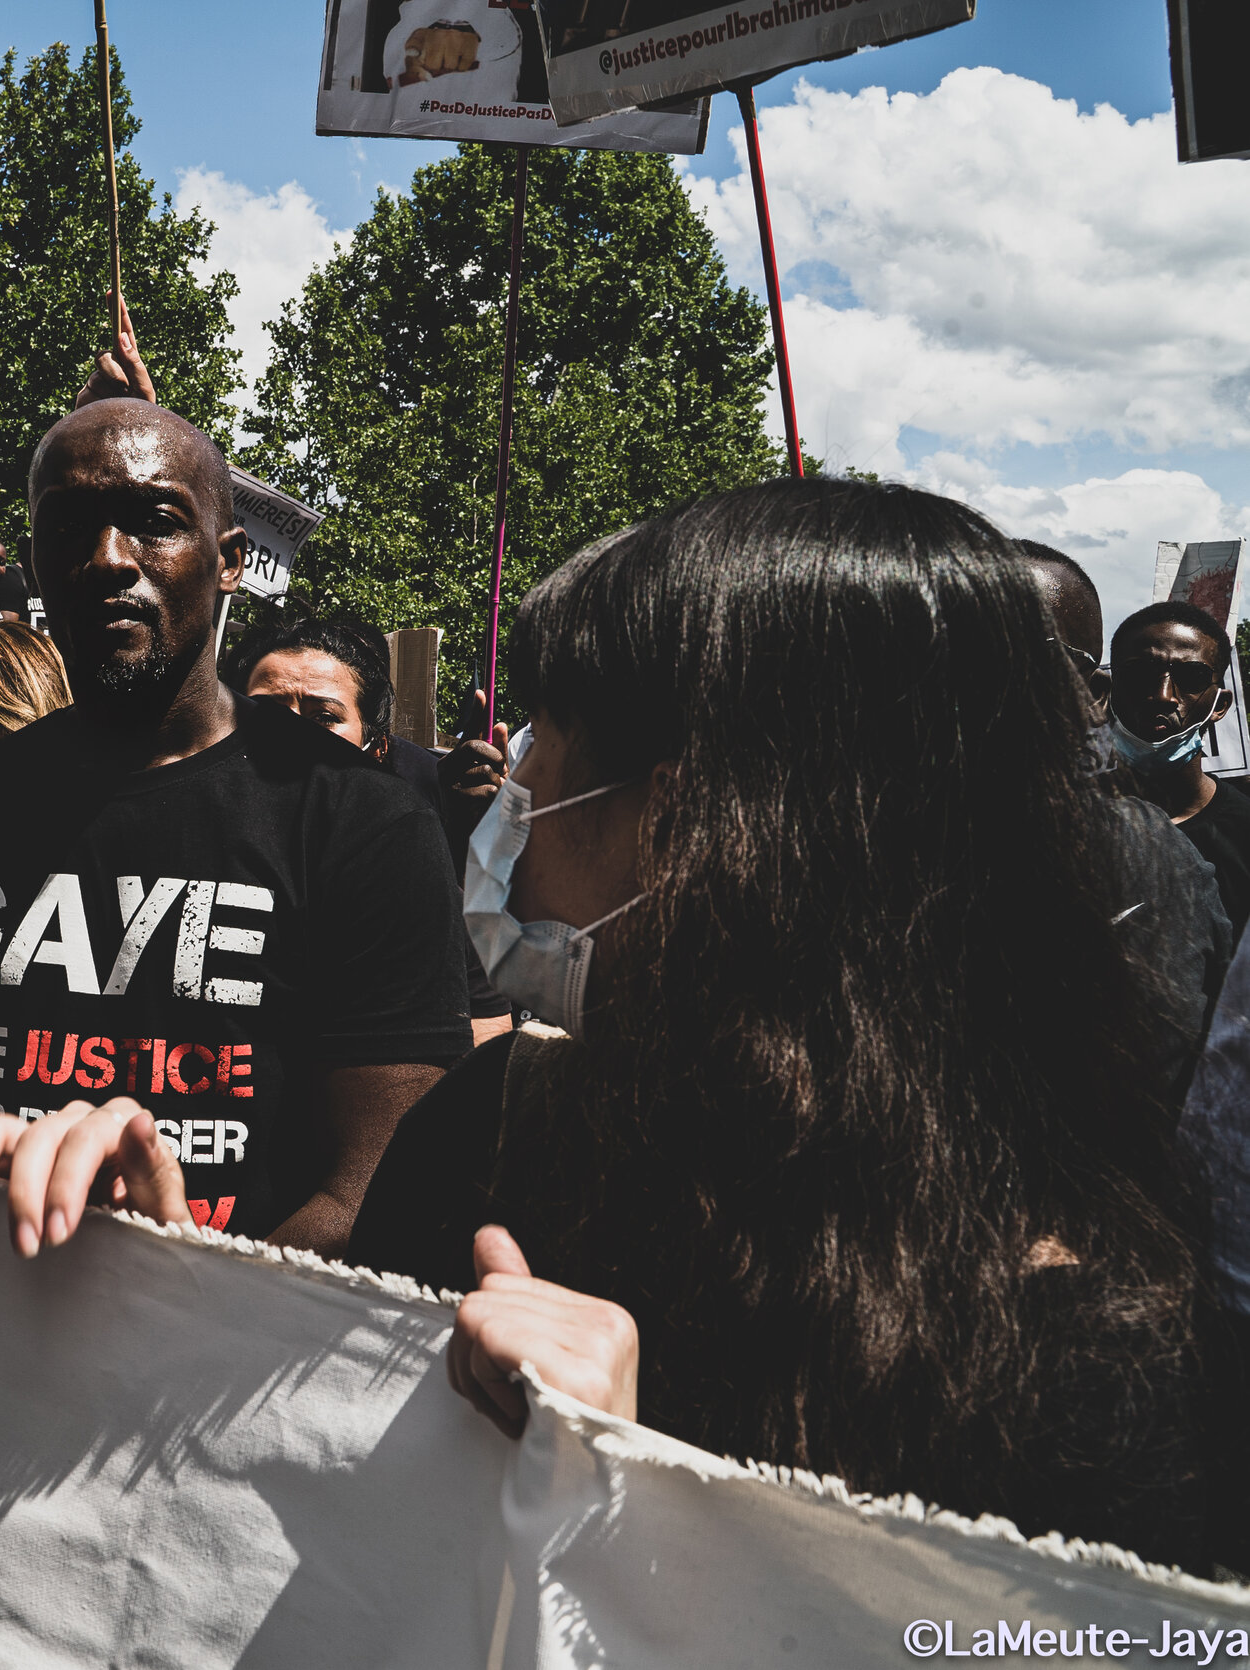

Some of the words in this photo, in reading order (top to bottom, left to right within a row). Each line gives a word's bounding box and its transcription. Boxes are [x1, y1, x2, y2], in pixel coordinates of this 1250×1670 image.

[419, 100, 555, 121] #PasDeJusticePasD
[243, 537, 281, 583] BRI
[16, 1029, 254, 1098] JUSTICE
